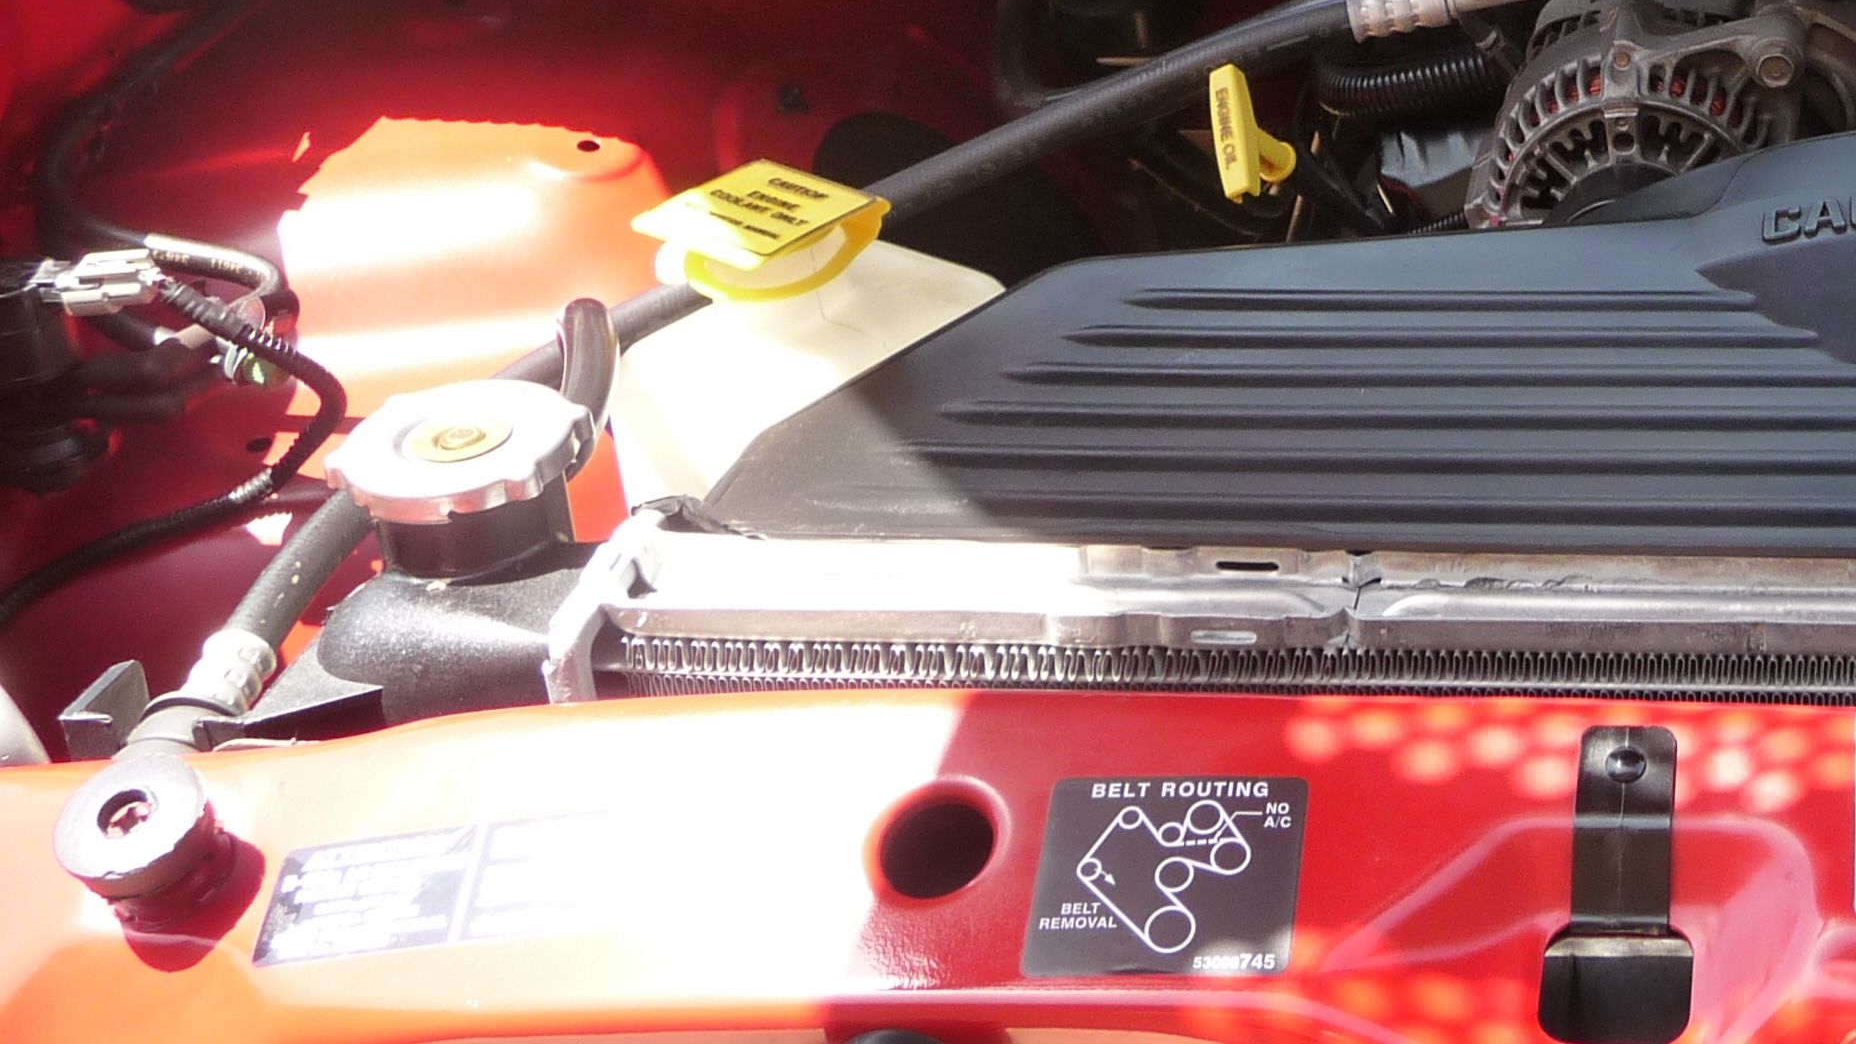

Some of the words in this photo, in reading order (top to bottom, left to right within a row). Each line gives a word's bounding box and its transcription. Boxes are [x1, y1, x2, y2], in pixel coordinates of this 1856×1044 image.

[1215, 87, 1233, 142] ENGINE
[1222, 143, 1237, 170] OIL
[709, 188, 771, 214] COOLANT
[770, 208, 809, 227] ONLY
[747, 190, 801, 211] ENGINE
[1091, 782, 1151, 798] BELT
[1161, 781, 1270, 798] ROUTING
[1265, 802, 1290, 815] NO
[1263, 815, 1292, 828] A/C
[1061, 902, 1101, 915] BELT
[1039, 916, 1117, 930] REMOVAL
